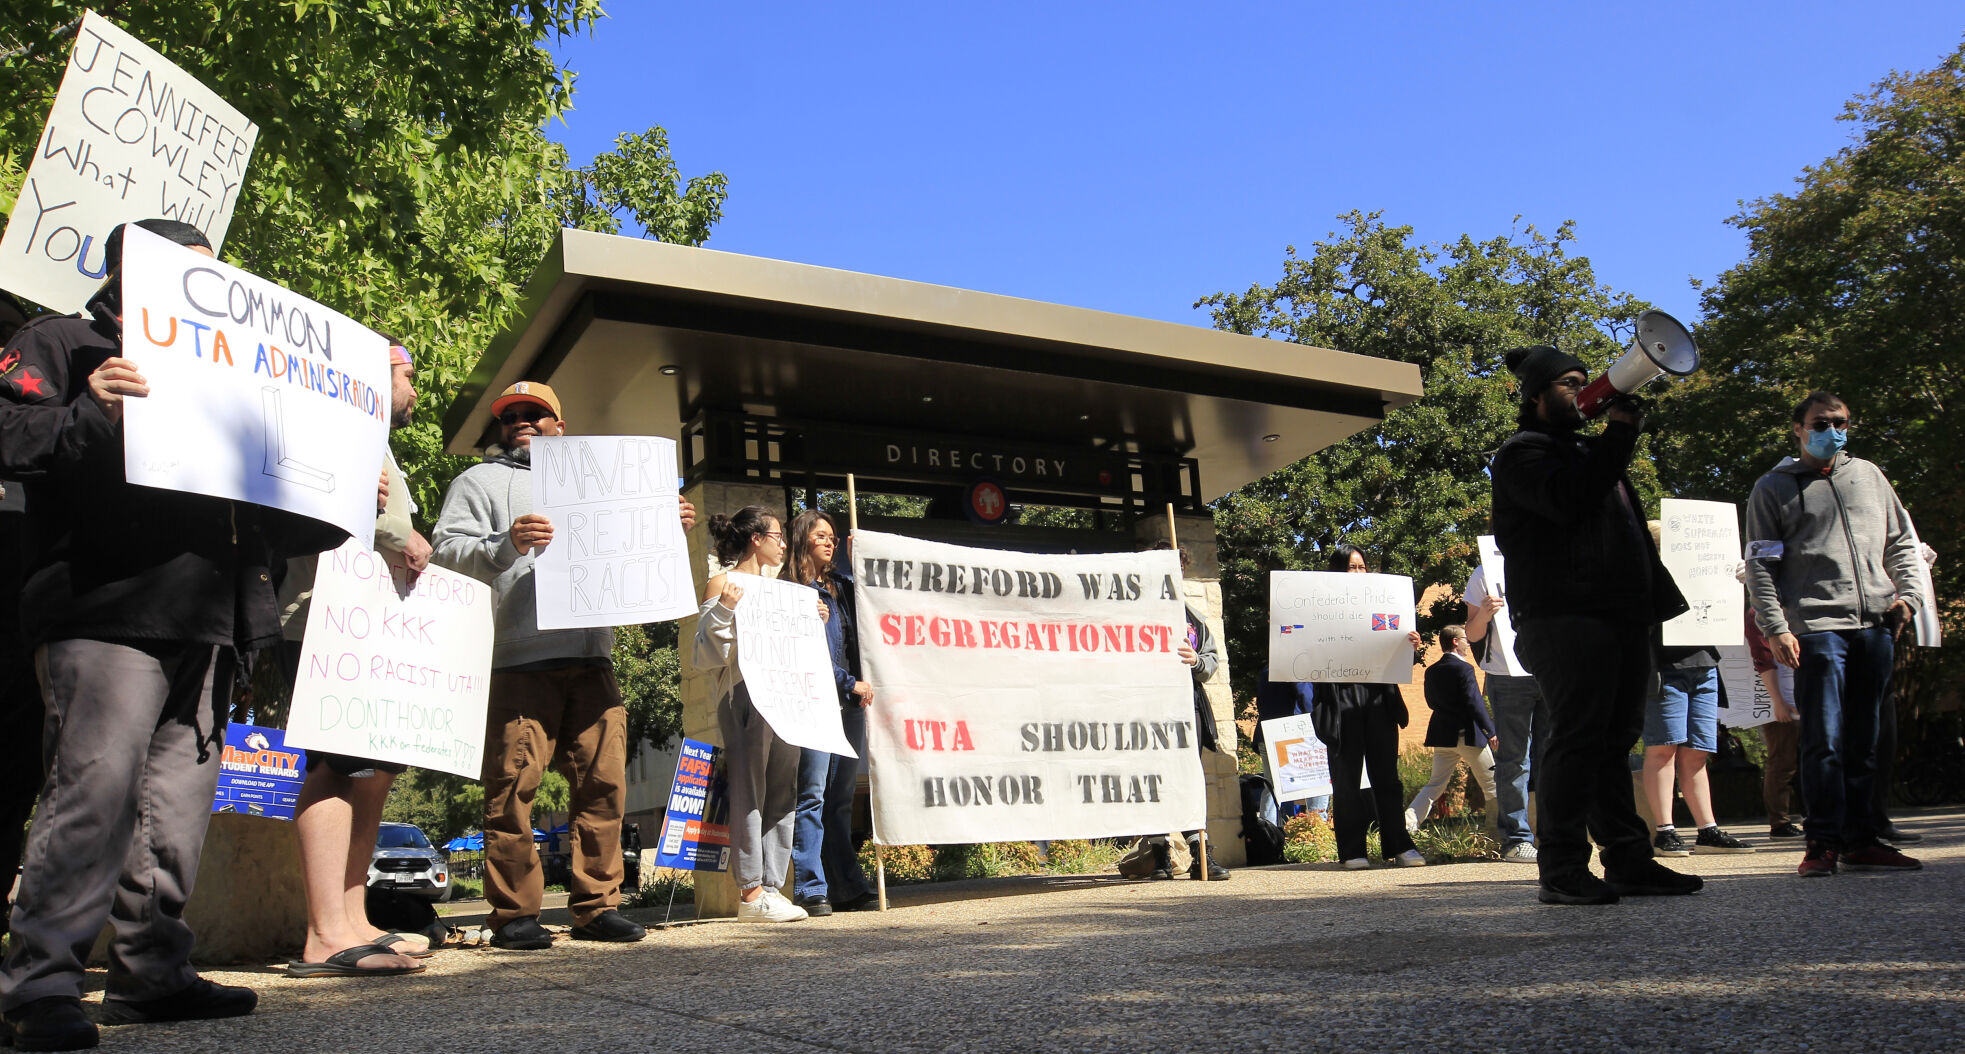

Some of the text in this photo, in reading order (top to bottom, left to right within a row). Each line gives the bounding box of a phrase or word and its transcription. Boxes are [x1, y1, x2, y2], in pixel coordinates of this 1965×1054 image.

[74, 27, 248, 177] JENNIFER
[44, 126, 137, 200] What
[82, 87, 238, 214] COWLEY
[183, 266, 332, 361] COMMON
[142, 306, 385, 423] UTA ADMINISTRATION
[887, 444, 1066, 477] DIRECTORY
[332, 547, 375, 580] NO
[863, 557, 1179, 601] HEREFORD WAS A
[1275, 577, 1396, 610] Confederate Pride
[324, 604, 437, 645] NO KKK
[1311, 610, 1364, 621] should die
[742, 630, 801, 668] DO NOT
[879, 613, 1173, 653] SEGREGATIONIST
[1317, 634, 1354, 644] with the
[309, 652, 361, 682] NO
[370, 654, 440, 689] RACIST
[1292, 651, 1371, 681] Confederacy
[398, 702, 455, 735] HONOR
[903, 718, 1192, 752] UTA SHOULDNT
[220, 761, 299, 778] TUDENT REWARDS
[679, 756, 713, 777] FAFSA
[683, 745, 716, 762] Next Year's
[231, 779, 258, 787] DOWNLOAD
[674, 782, 681, 793] is
[923, 774, 1162, 808] HONOR THAT
[670, 794, 705, 816] NOW!
